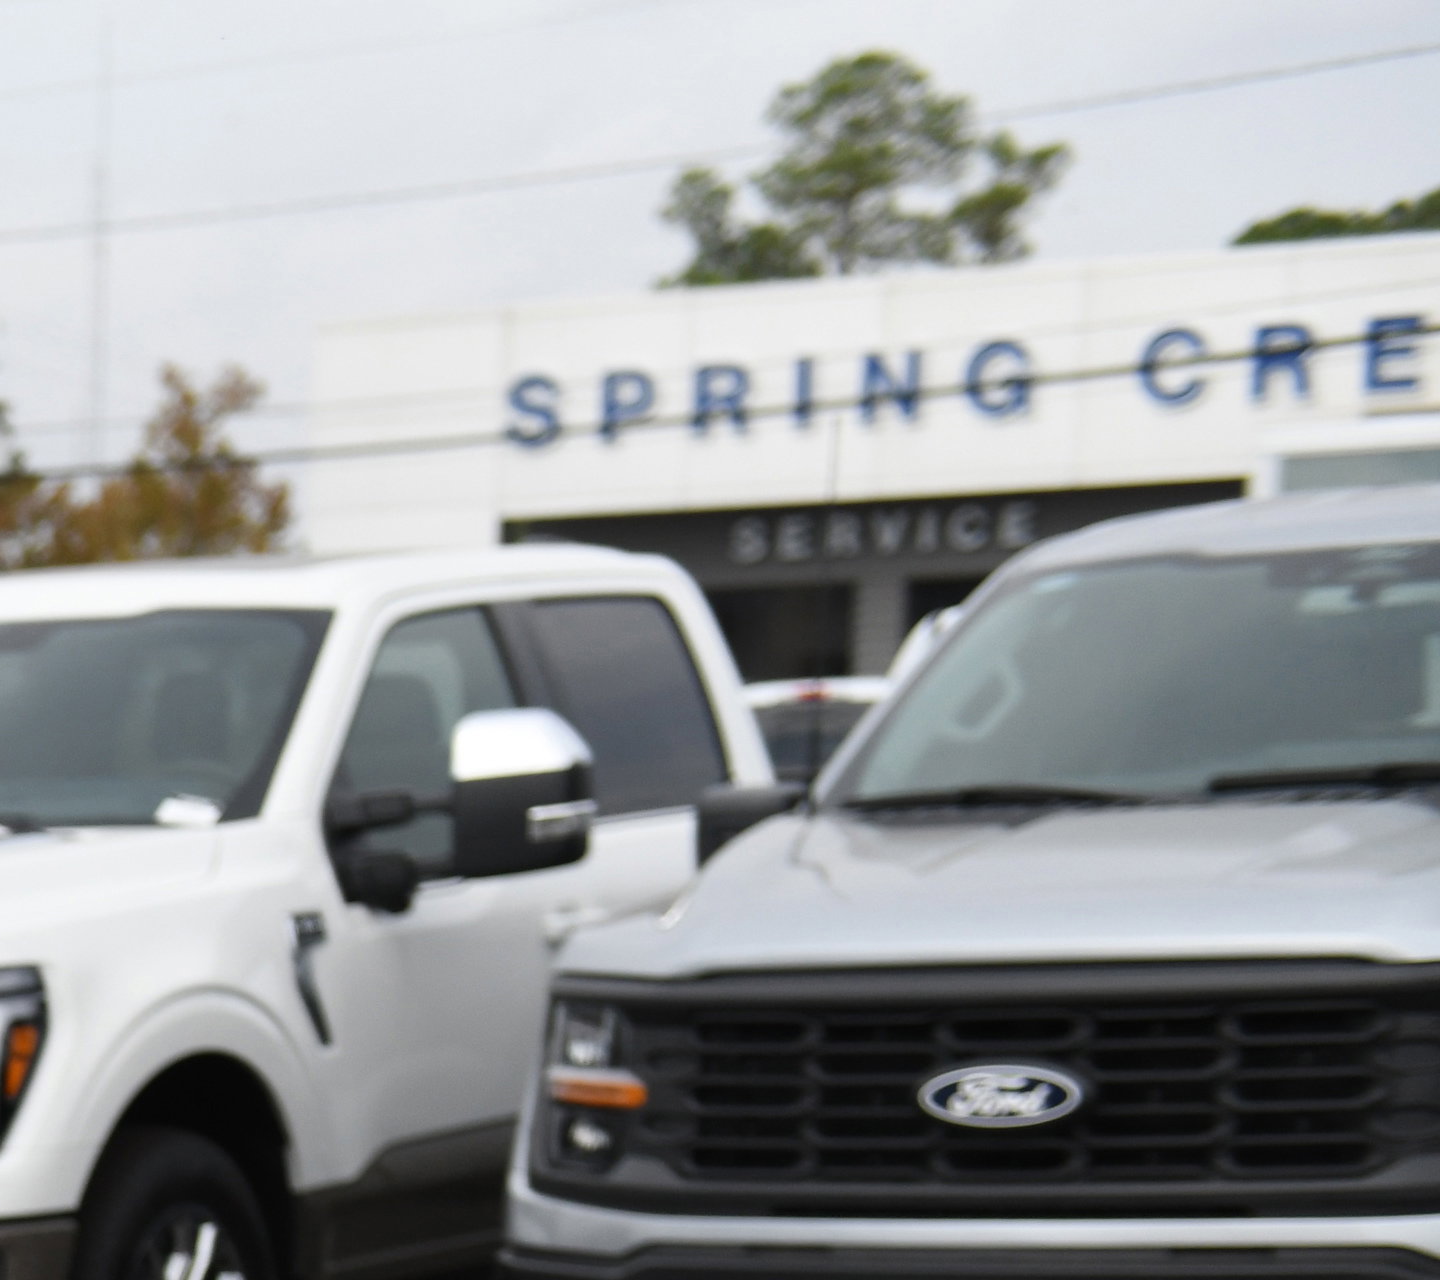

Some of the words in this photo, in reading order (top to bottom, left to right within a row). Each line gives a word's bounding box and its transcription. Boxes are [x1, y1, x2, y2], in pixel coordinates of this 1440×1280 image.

[505, 340, 1035, 448] SPRING
[730, 501, 1038, 565] SERVICE
[946, 1073, 1053, 1117] Ford
